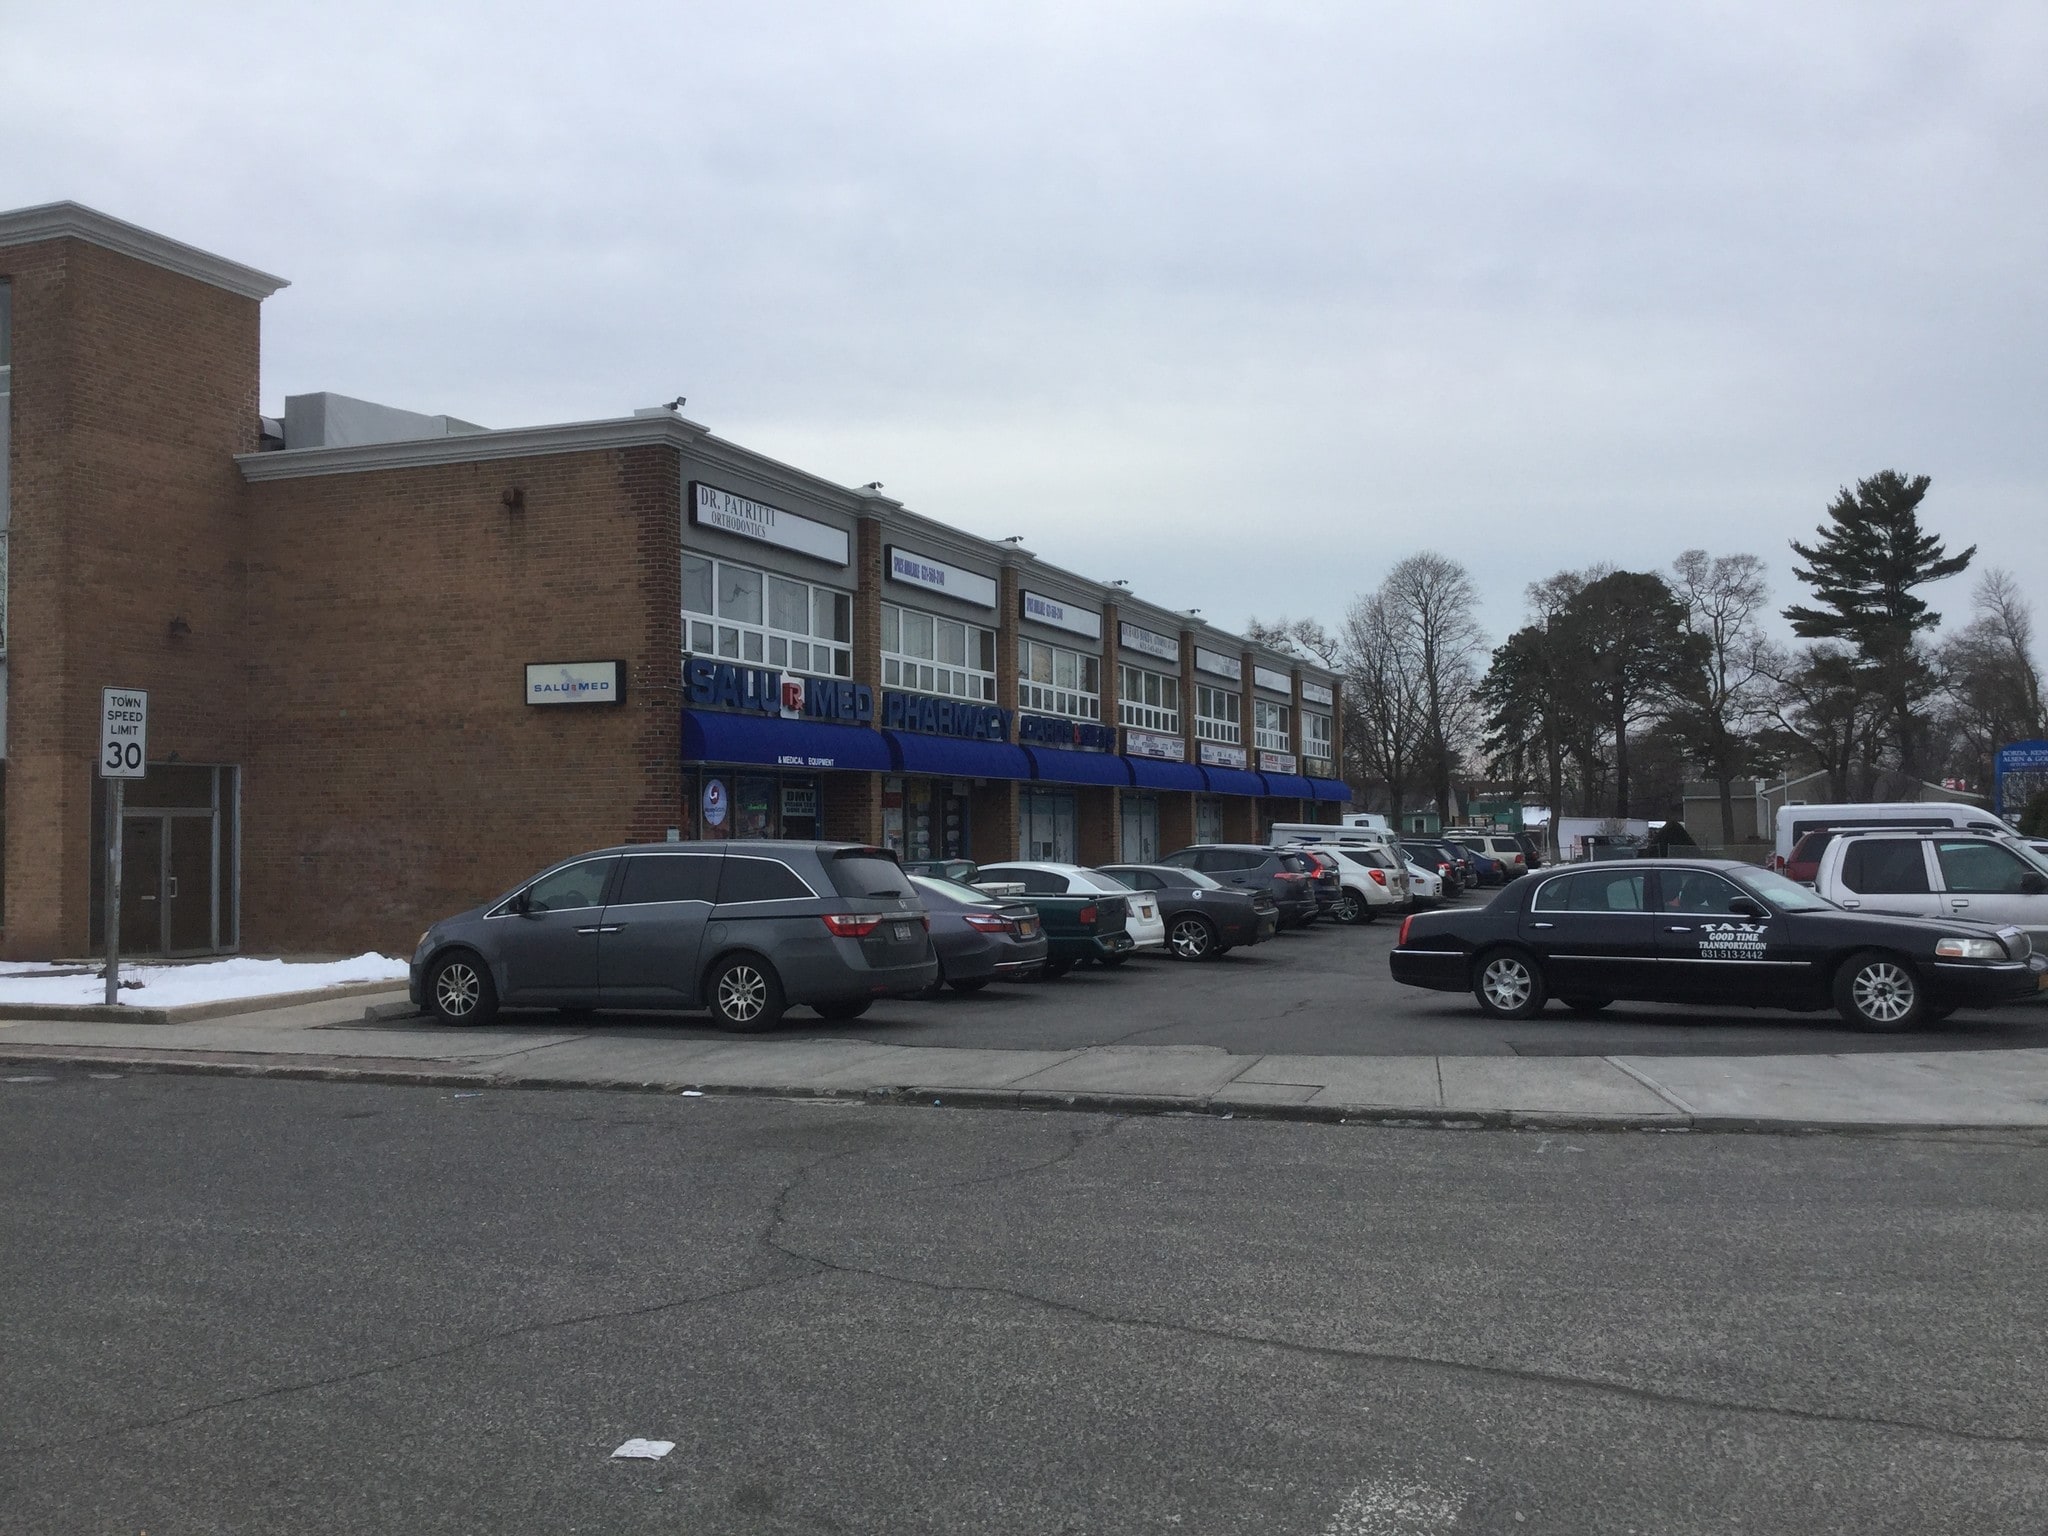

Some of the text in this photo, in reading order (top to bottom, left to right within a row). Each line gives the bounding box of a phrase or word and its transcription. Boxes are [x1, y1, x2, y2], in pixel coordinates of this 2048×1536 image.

[701, 487, 774, 527] DR. PATRITTI
[711, 511, 765, 538] ORTHODONTICS
[534, 682, 609, 692] SALU MED
[684, 658, 781, 713] SALU
[806, 677, 874, 722] MED
[111, 696, 141, 708] TOWN
[107, 710, 143, 722] SPEED
[883, 691, 1014, 741] PHARMACY
[110, 725, 138, 735] LIMIT
[106, 741, 142, 770] 30
[783, 755, 804, 765] MEDICAL
[808, 756, 835, 767] EQUIPMENT
[787, 791, 813, 801] DMV
[1700, 922, 1768, 934] TAXI
[1708, 932, 1759, 941] GOOD TIME
[1698, 941, 1767, 950] TRANSPORTATION
[1701, 949, 1763, 959] 631-513-2442
